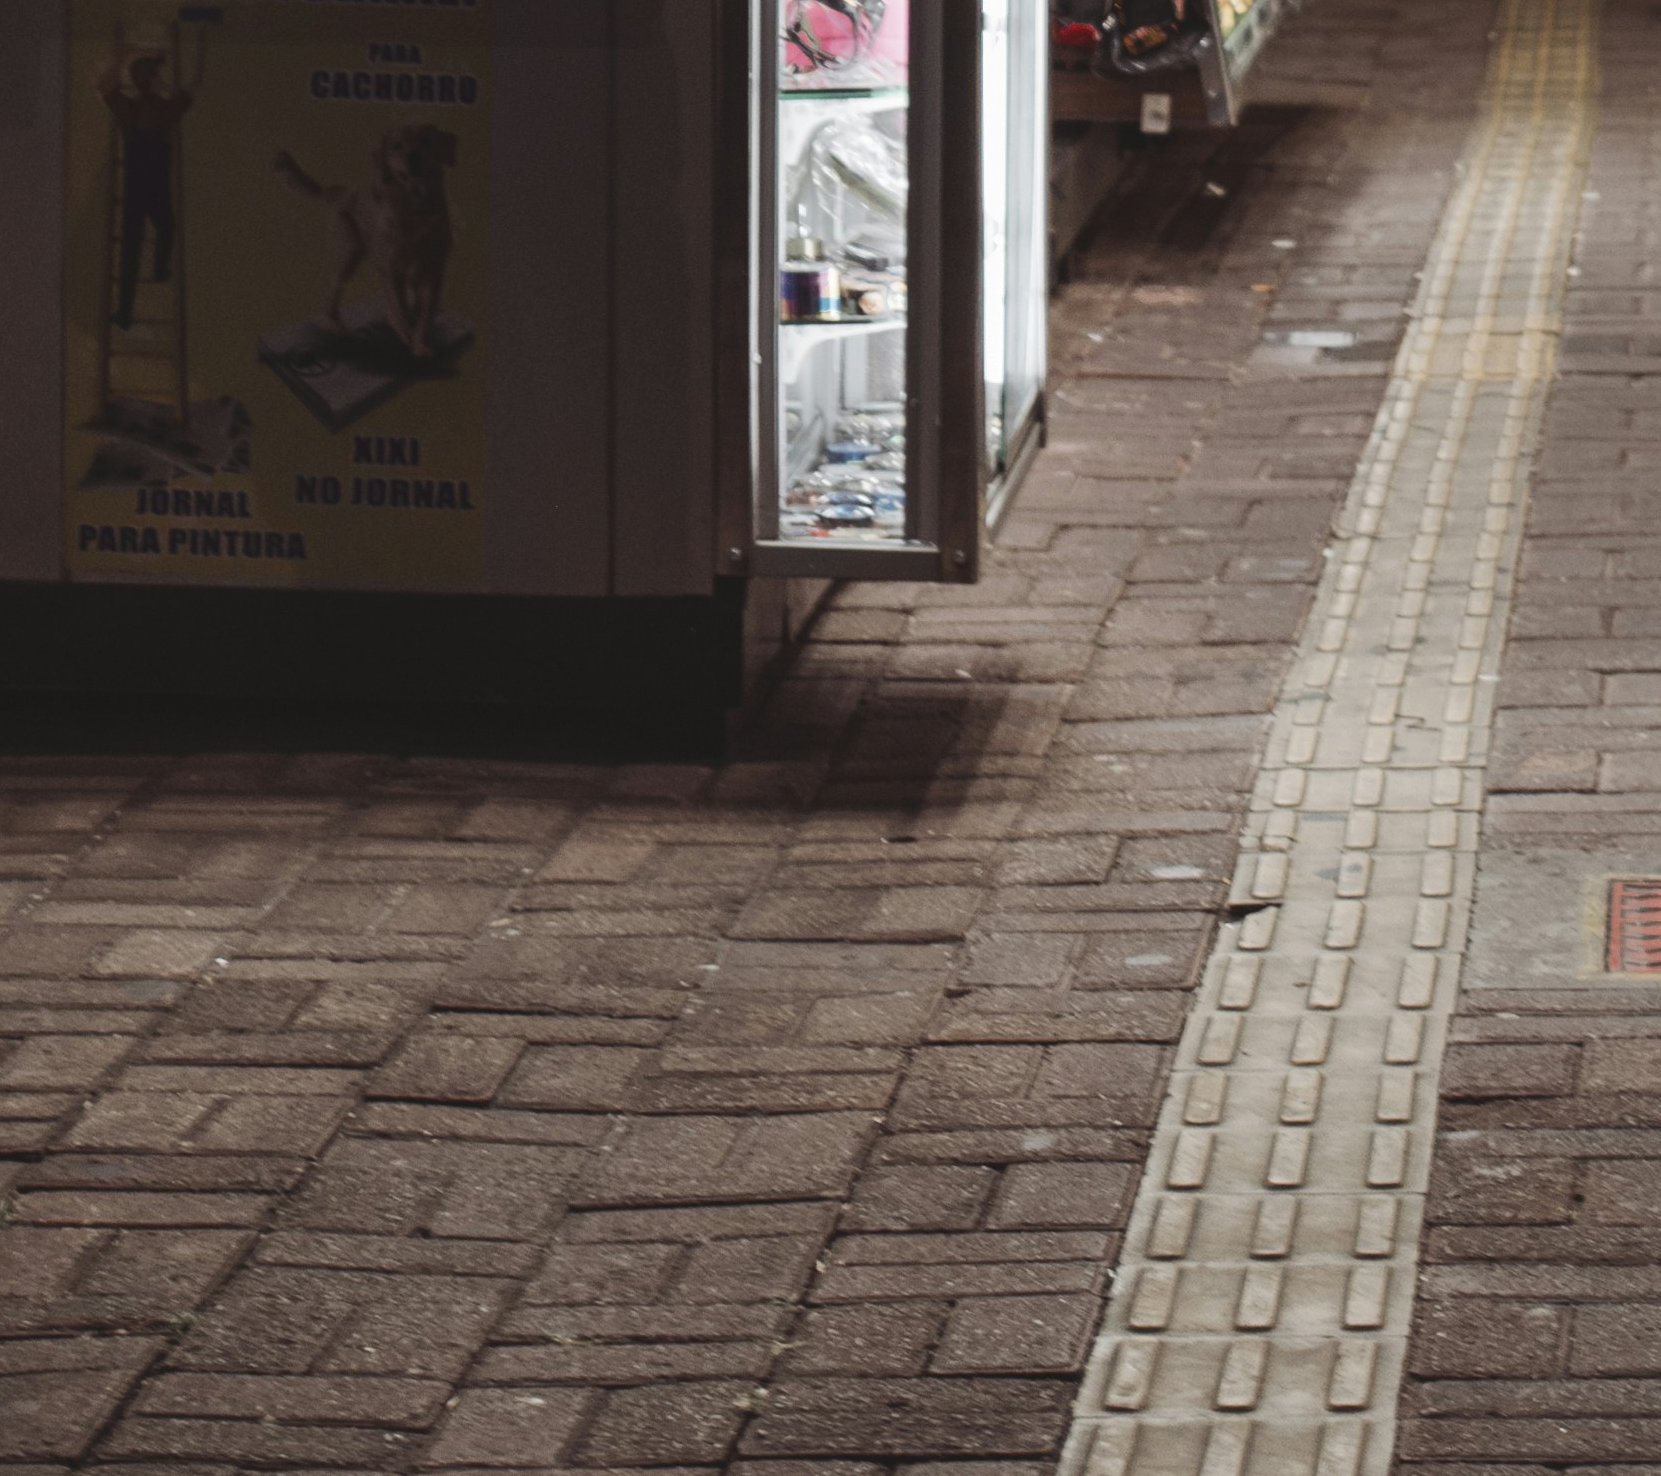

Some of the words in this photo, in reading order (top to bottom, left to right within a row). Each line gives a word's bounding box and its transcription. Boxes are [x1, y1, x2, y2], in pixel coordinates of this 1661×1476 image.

[368, 43, 422, 65] PARA
[310, 69, 480, 106] CACHORRO
[353, 435, 421, 466] XIXI
[136, 486, 251, 519] JORNAL
[294, 476, 342, 506] NO
[350, 478, 475, 510] JORNAL
[78, 523, 161, 555] PARA
[168, 526, 308, 559] PINTURA
